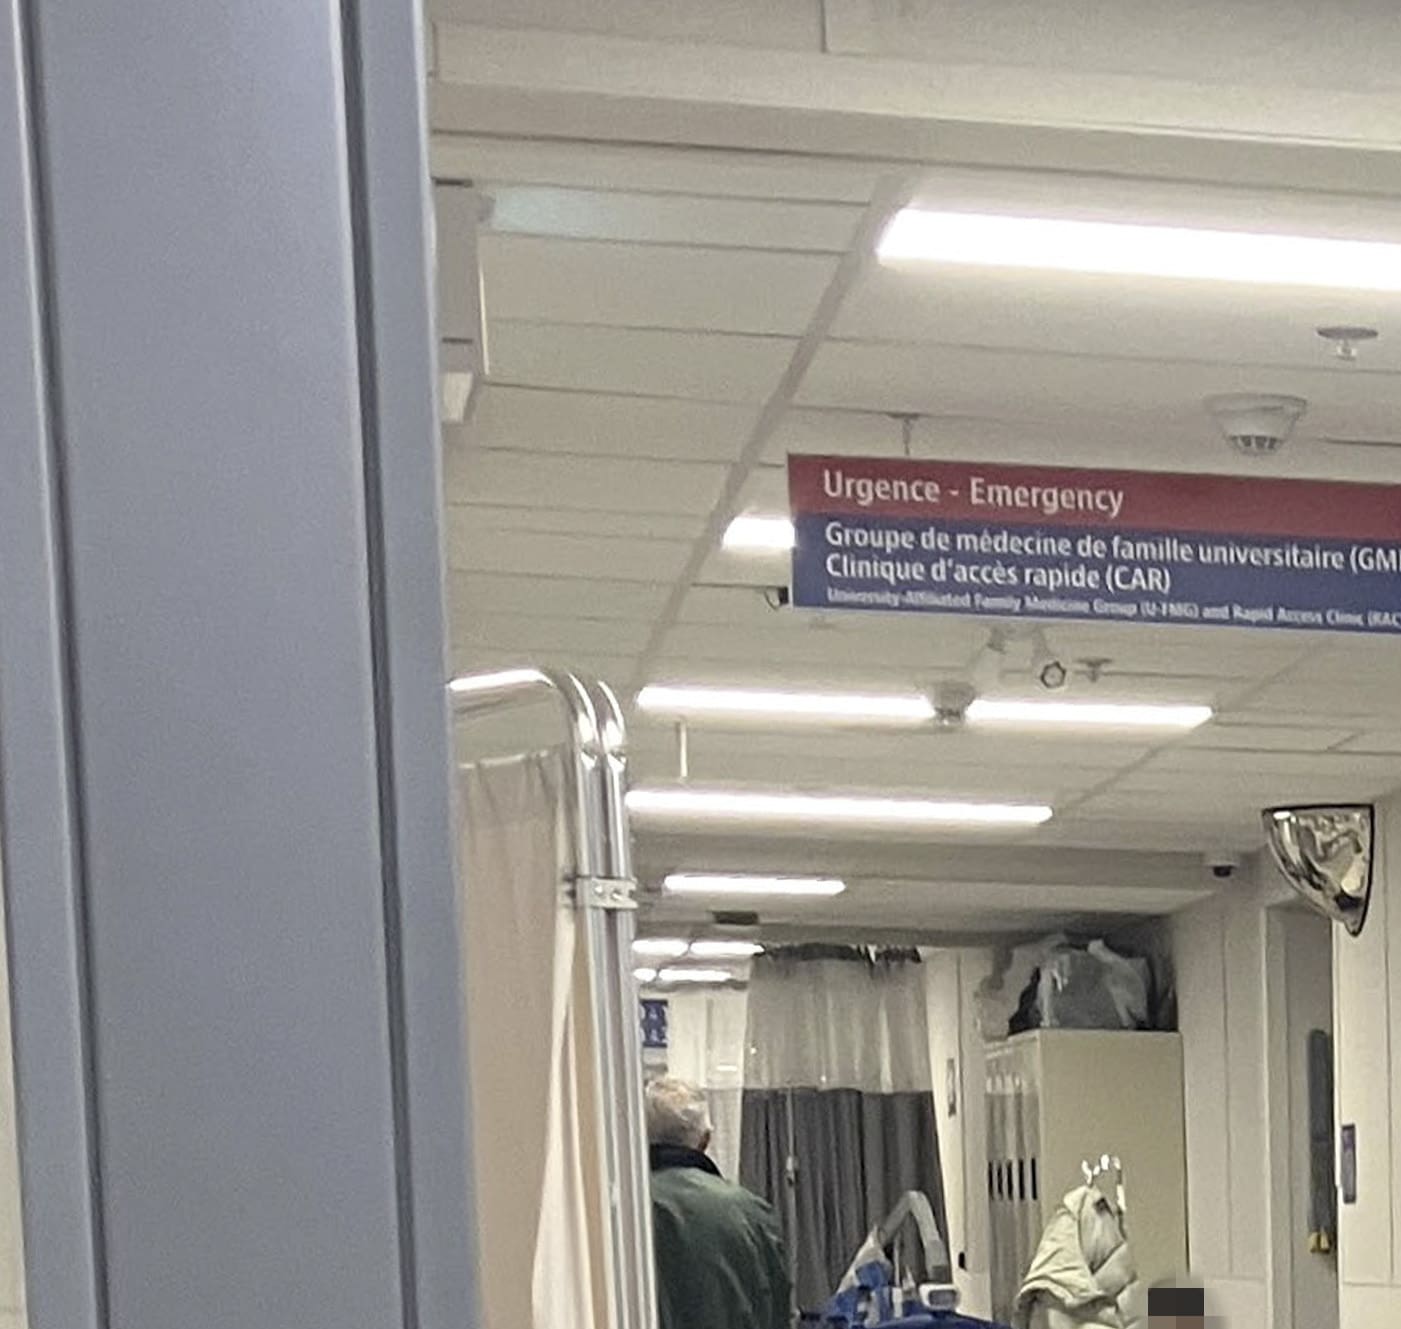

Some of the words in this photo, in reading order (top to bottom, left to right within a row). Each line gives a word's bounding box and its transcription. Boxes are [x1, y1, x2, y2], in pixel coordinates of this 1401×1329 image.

[823, 469, 941, 506] Urgence
[969, 477, 1125, 519] Emergency
[825, 522, 916, 552] Groupe
[920, 527, 950, 551] de
[956, 527, 1072, 557] médecine
[1077, 535, 1106, 559] de
[1112, 535, 1193, 563] famille
[1199, 540, 1345, 570] universitaire
[826, 553, 925, 584] Clinique
[931, 558, 1018, 585] d'accès
[1024, 563, 1099, 590] rapide
[1105, 566, 1171, 594] (CAR)
